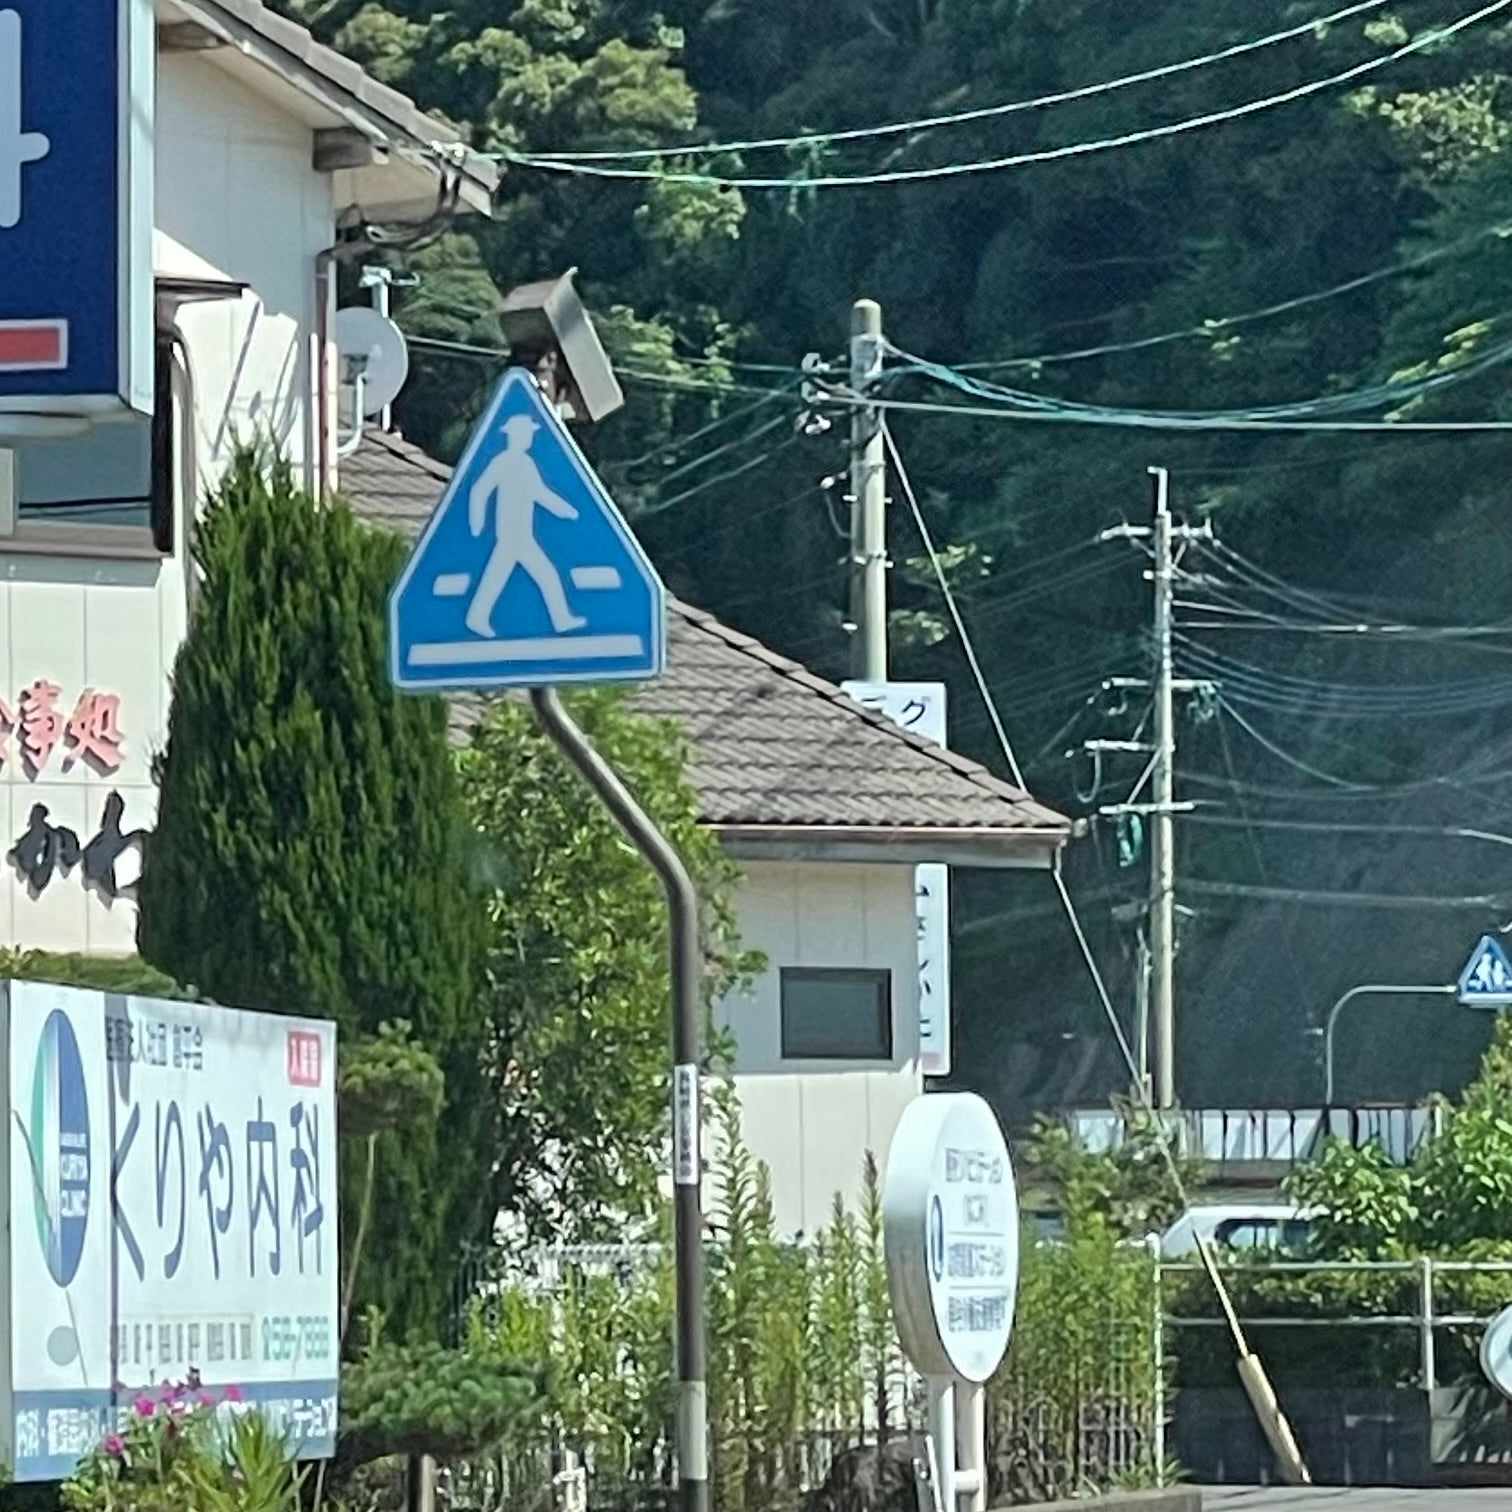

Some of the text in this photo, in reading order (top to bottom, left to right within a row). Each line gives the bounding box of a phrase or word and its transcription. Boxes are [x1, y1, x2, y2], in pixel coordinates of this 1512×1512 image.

[110, 1095, 324, 1281] くりや内科
